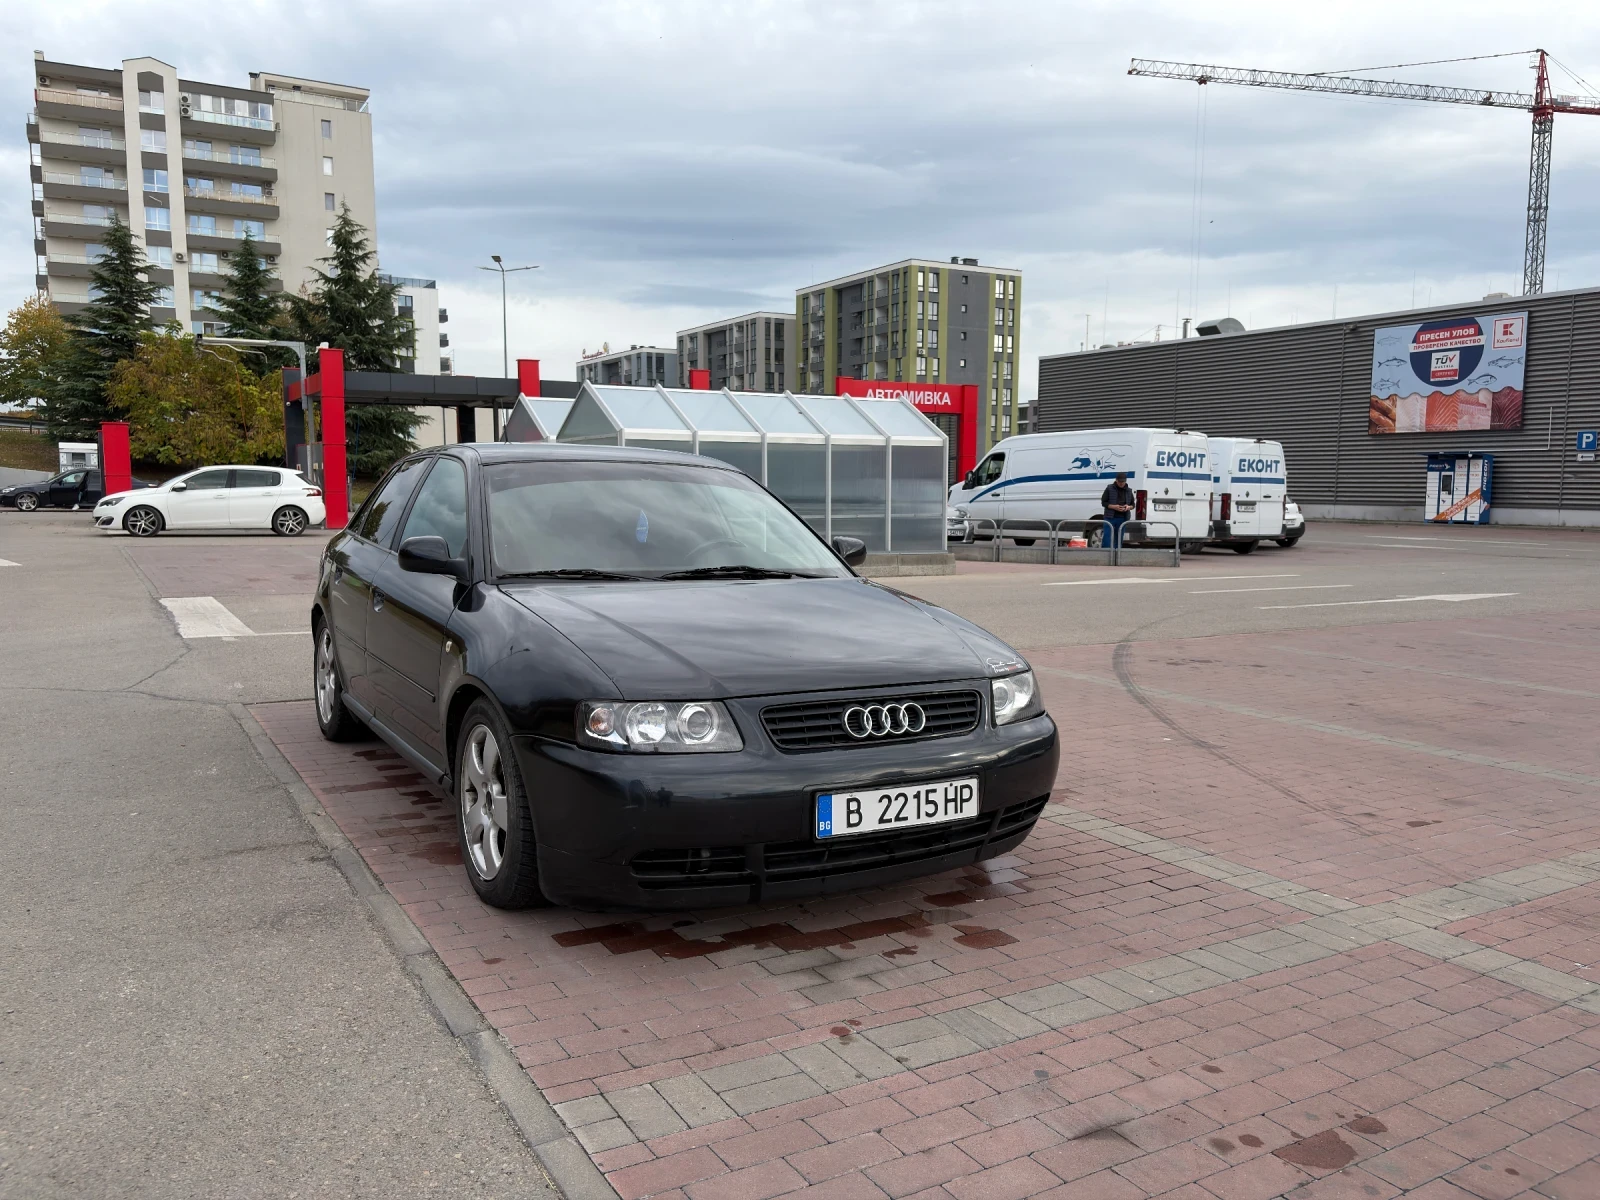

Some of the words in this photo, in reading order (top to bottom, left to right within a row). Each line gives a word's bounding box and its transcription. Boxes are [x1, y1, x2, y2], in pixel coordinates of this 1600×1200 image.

[1419, 331, 1451, 342] ПРЕСЕН
[1452, 327, 1475, 337] УЛОВ
[1413, 341, 1449, 351] ПРОВЕРЕНО
[1449, 338, 1482, 347] КАЧЕСТВО
[866, 388, 952, 406] АВТОМИВКА
[1581, 433, 1594, 449] P
[1156, 450, 1206, 469] ЕКОНТ
[1238, 458, 1280, 474] ЕКОНТ
[846, 797, 863, 829] B
[877, 788, 939, 825] 2215
[944, 784, 974, 816] HP
[819, 820, 831, 831] BG
